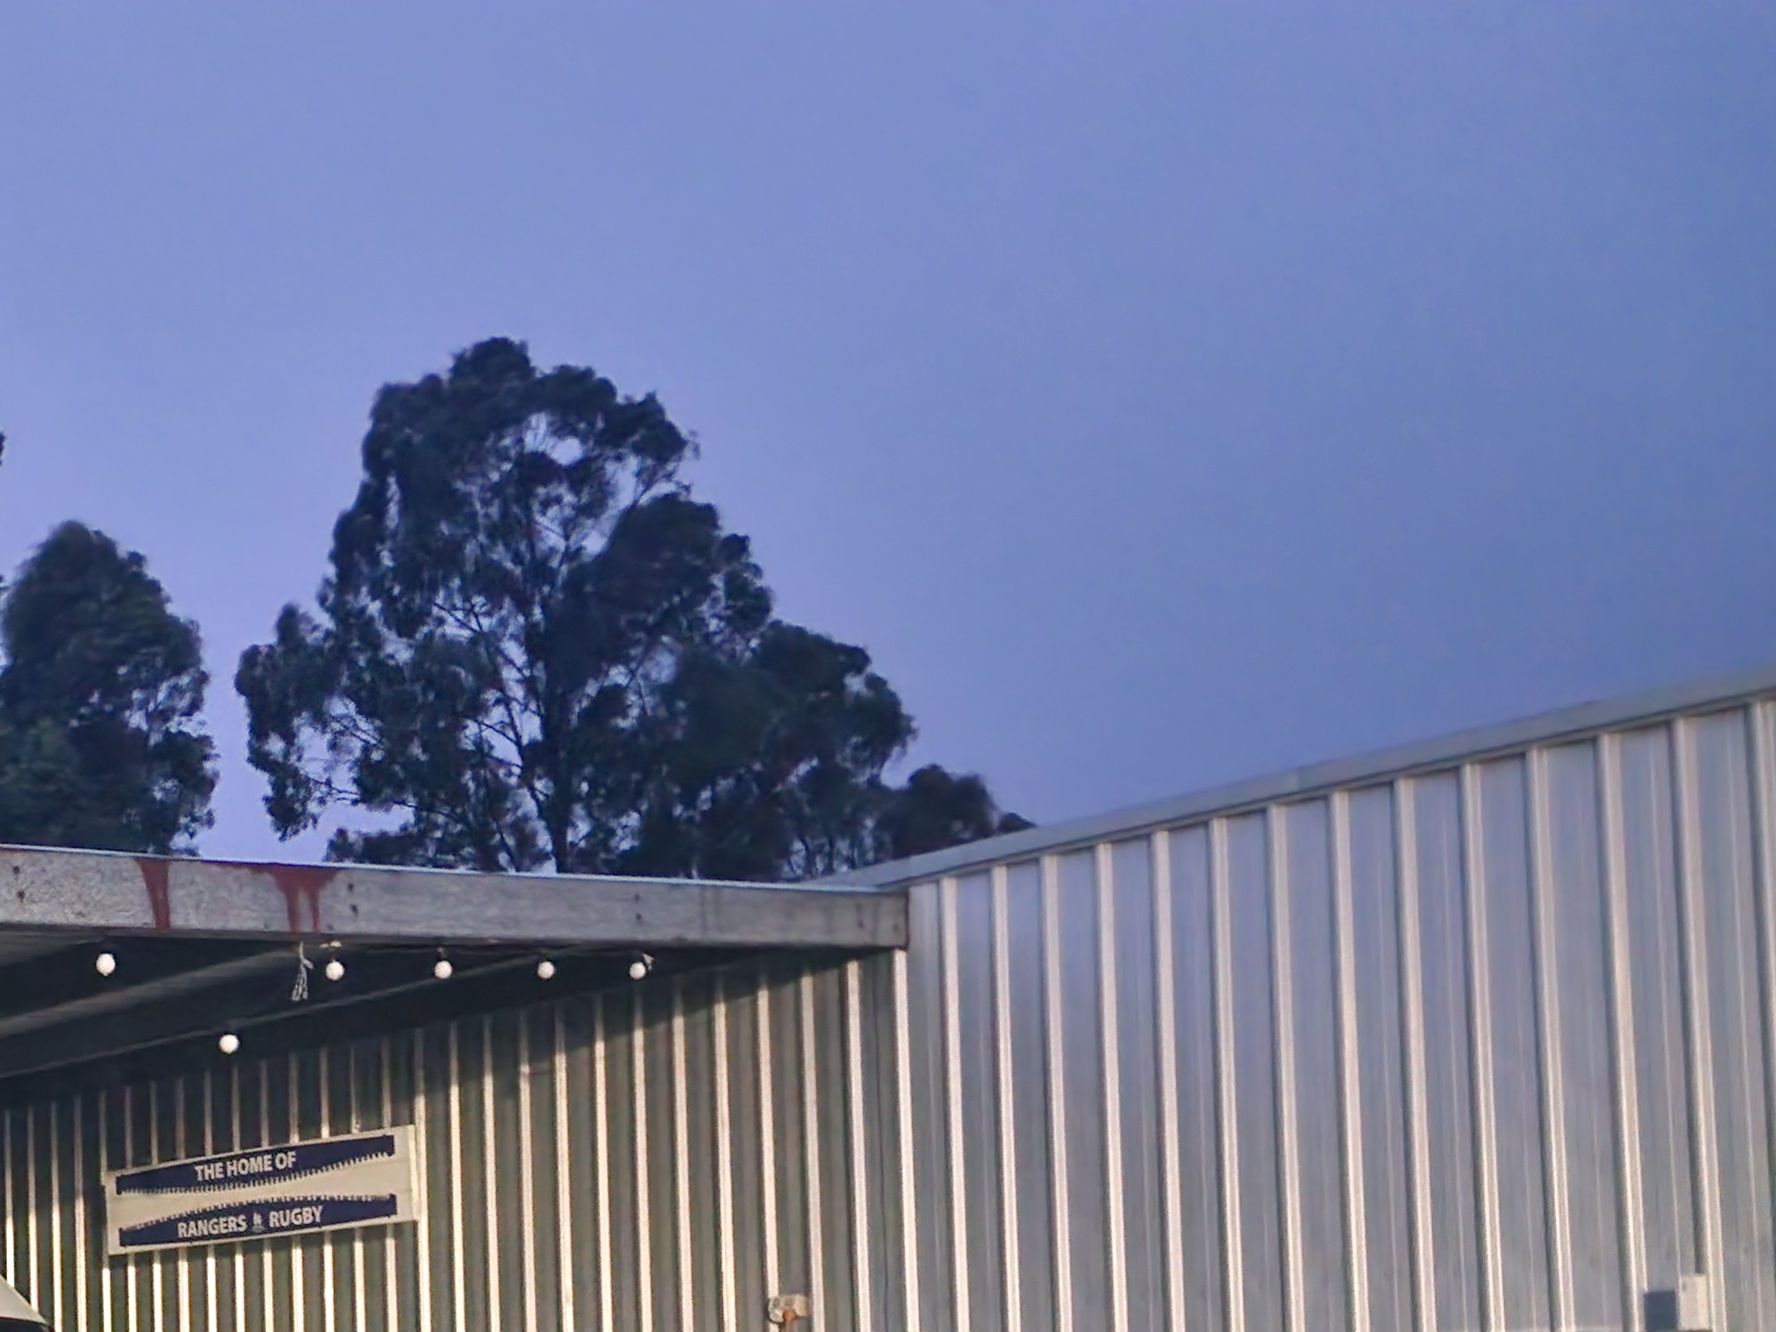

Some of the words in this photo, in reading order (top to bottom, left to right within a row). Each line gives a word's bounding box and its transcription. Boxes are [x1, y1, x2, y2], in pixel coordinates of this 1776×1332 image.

[194, 1163, 224, 1182] THE
[226, 1155, 273, 1177] HOME
[274, 1151, 297, 1170] OF
[177, 1214, 248, 1238] RANGERS
[268, 1205, 323, 1228] RUGBY
